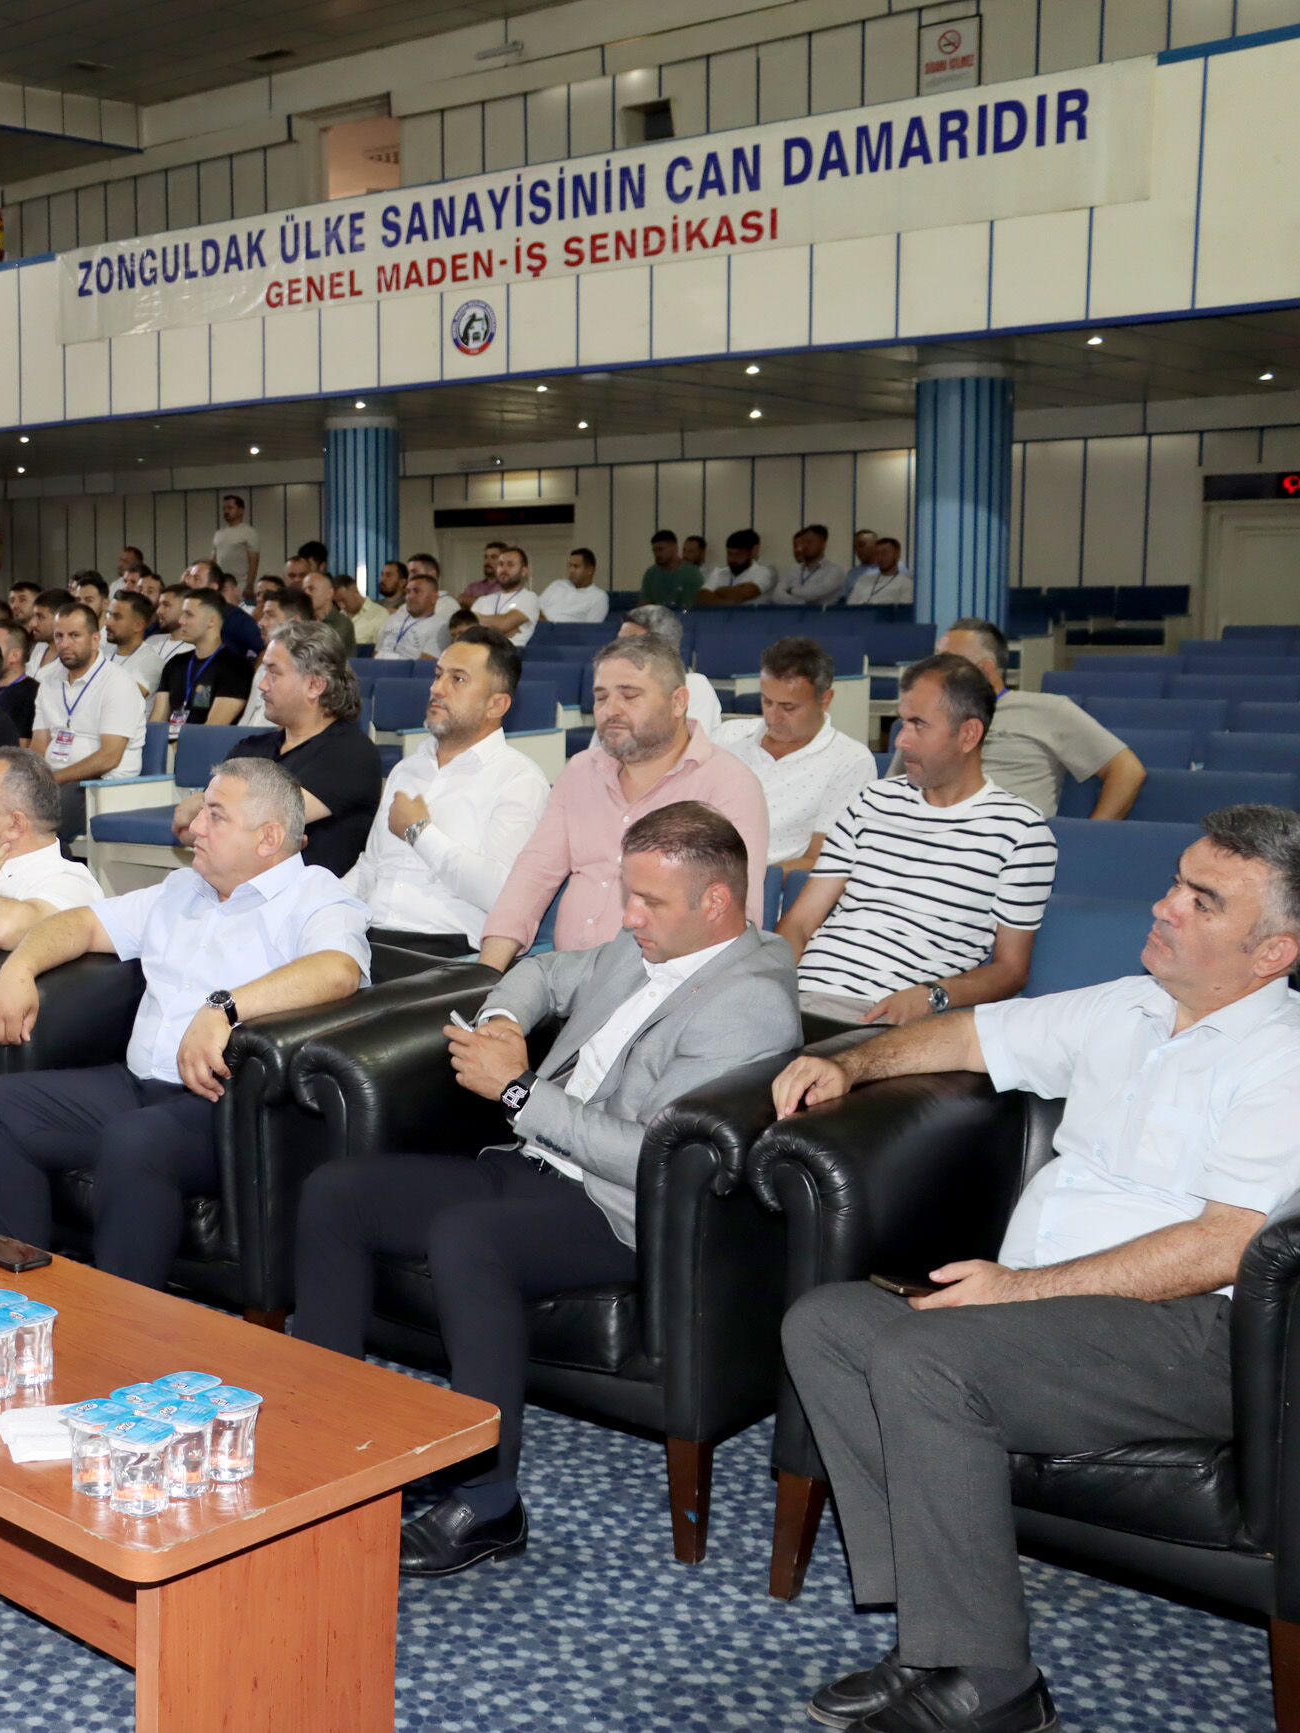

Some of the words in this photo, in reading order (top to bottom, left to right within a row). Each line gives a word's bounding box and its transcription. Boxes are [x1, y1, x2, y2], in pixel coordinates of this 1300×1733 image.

[78, 229, 267, 297] ZONGULDAK
[280, 212, 365, 264] ÜLKE
[381, 158, 646, 248] SANAYİSİNİN
[665, 144, 761, 204] CAN
[783, 88, 1089, 187] DAMARIDIR
[265, 269, 364, 309] GENEL
[377, 237, 548, 294] MADEN-İŞ
[563, 207, 779, 268] SENDİKASI
